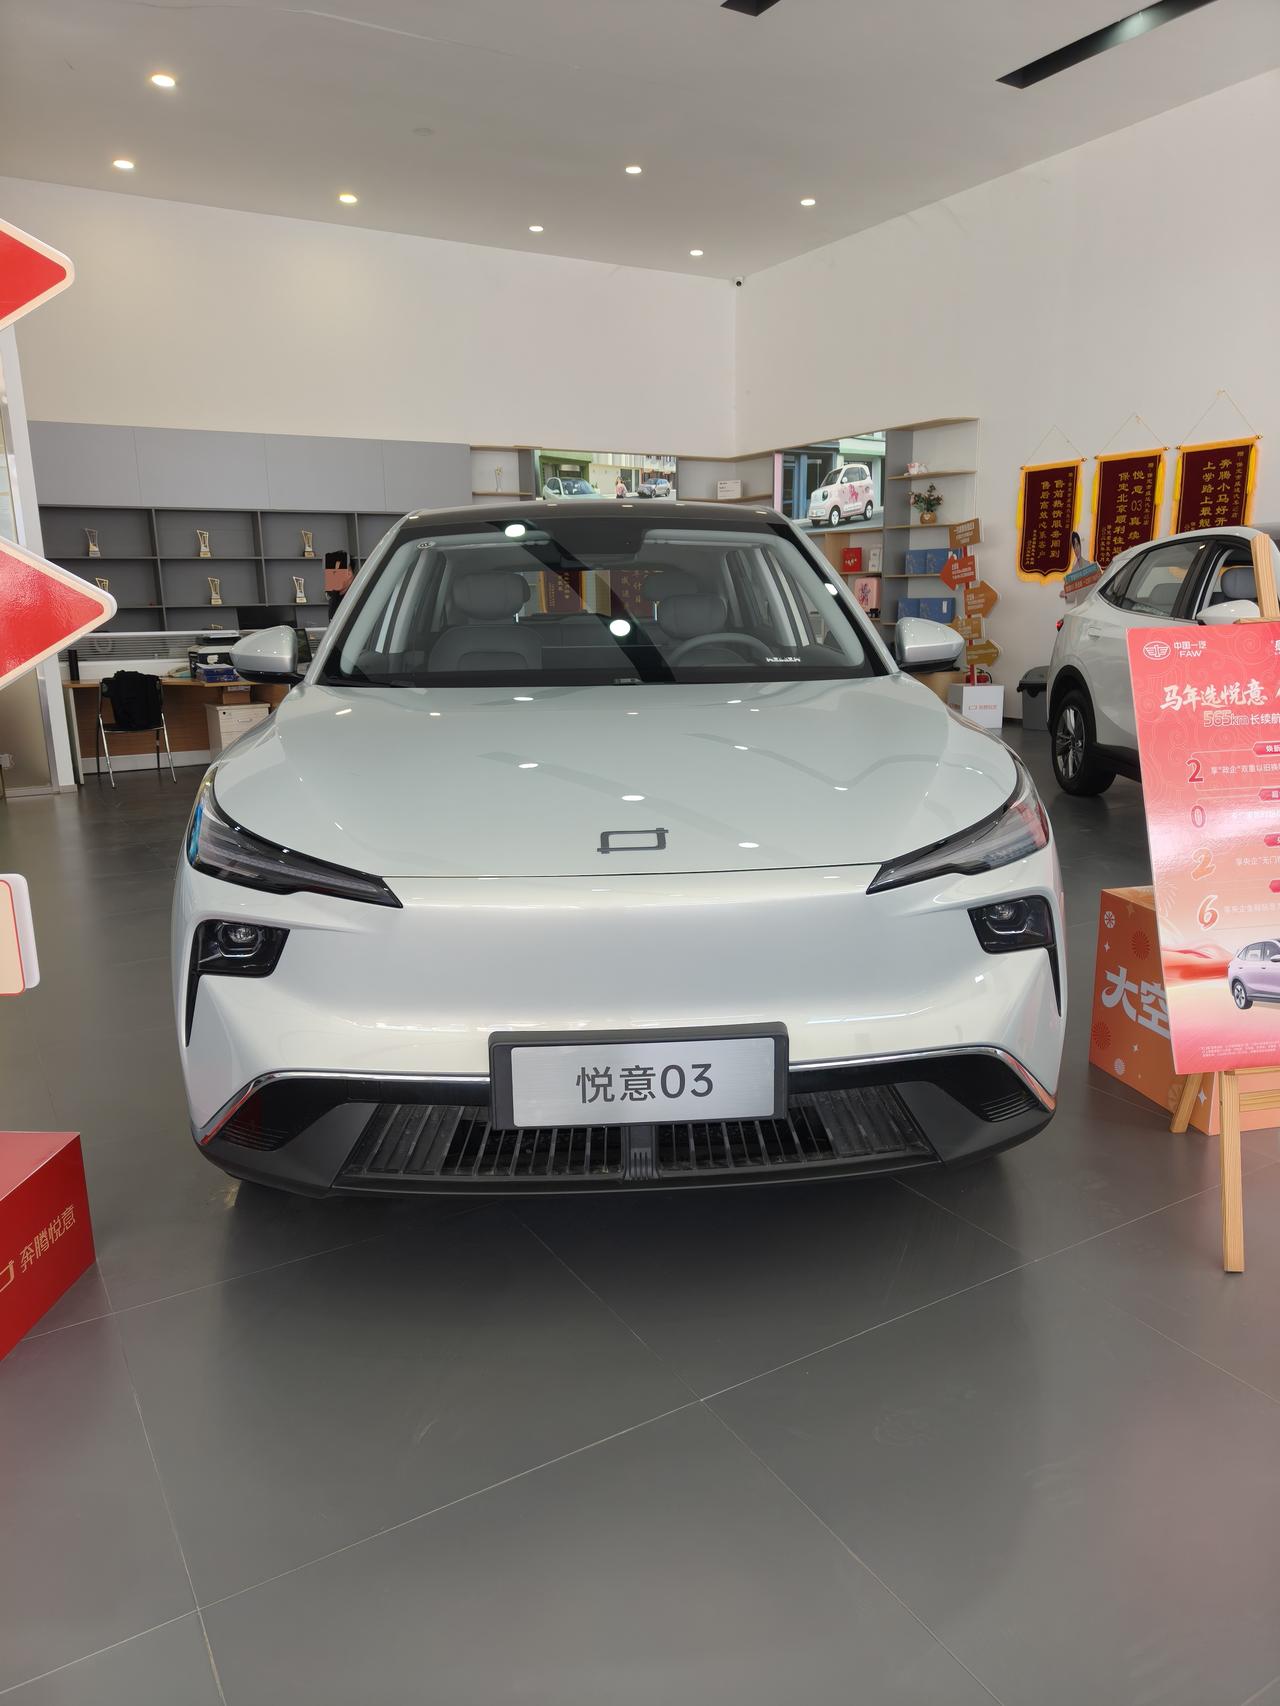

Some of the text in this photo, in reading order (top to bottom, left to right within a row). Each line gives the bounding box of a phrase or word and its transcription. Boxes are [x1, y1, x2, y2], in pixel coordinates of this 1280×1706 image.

[1173, 640, 1207, 650] 中国一汽
[1160, 678, 1268, 712] 马年选悦意
[1185, 758, 1204, 783] 2
[1197, 894, 1219, 929] 6
[575, 1063, 714, 1104] 悦意03
[19, 1204, 76, 1273] 奔腾悦意
